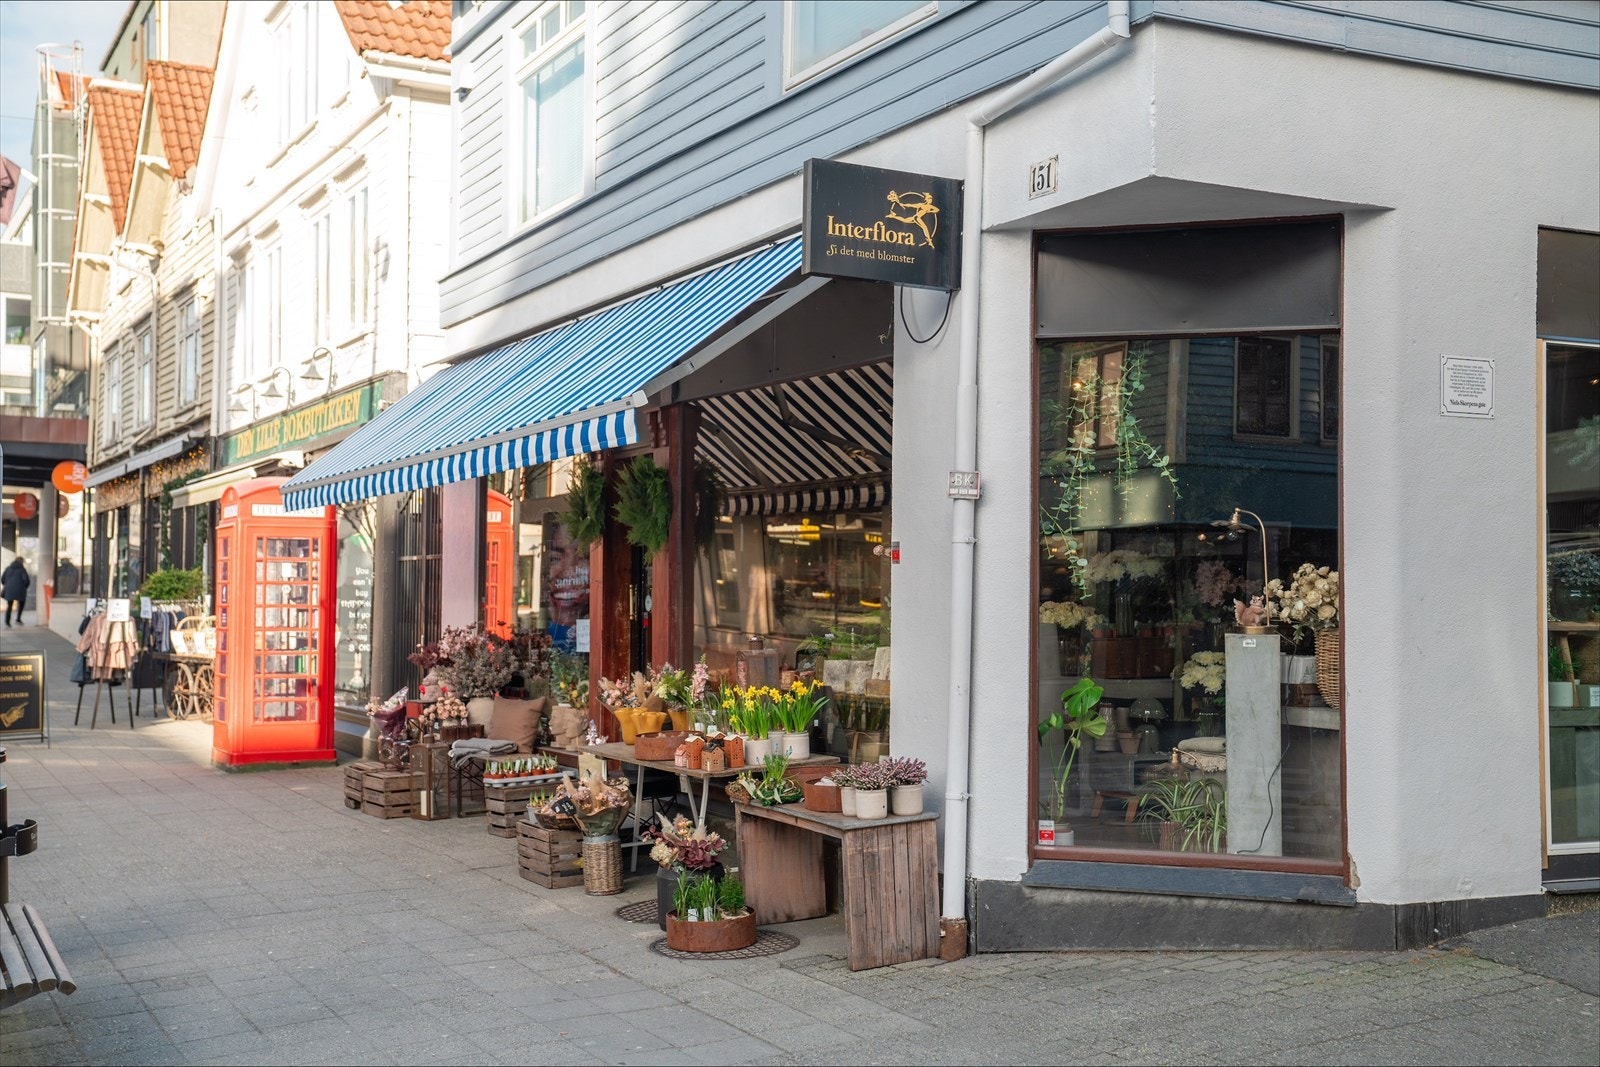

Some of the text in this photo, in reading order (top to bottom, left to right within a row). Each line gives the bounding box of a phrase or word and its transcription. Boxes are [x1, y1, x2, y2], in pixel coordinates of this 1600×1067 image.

[1032, 162, 1052, 193] 151
[827, 215, 915, 246] Interflora
[827, 244, 915, 264] Si det med blomster
[236, 388, 361, 459] DEN LILLE BOKBUTIKKEN
[355, 567, 369, 576] You
[361, 612, 371, 620] yo
[0, 664, 33, 673] NGLISH
